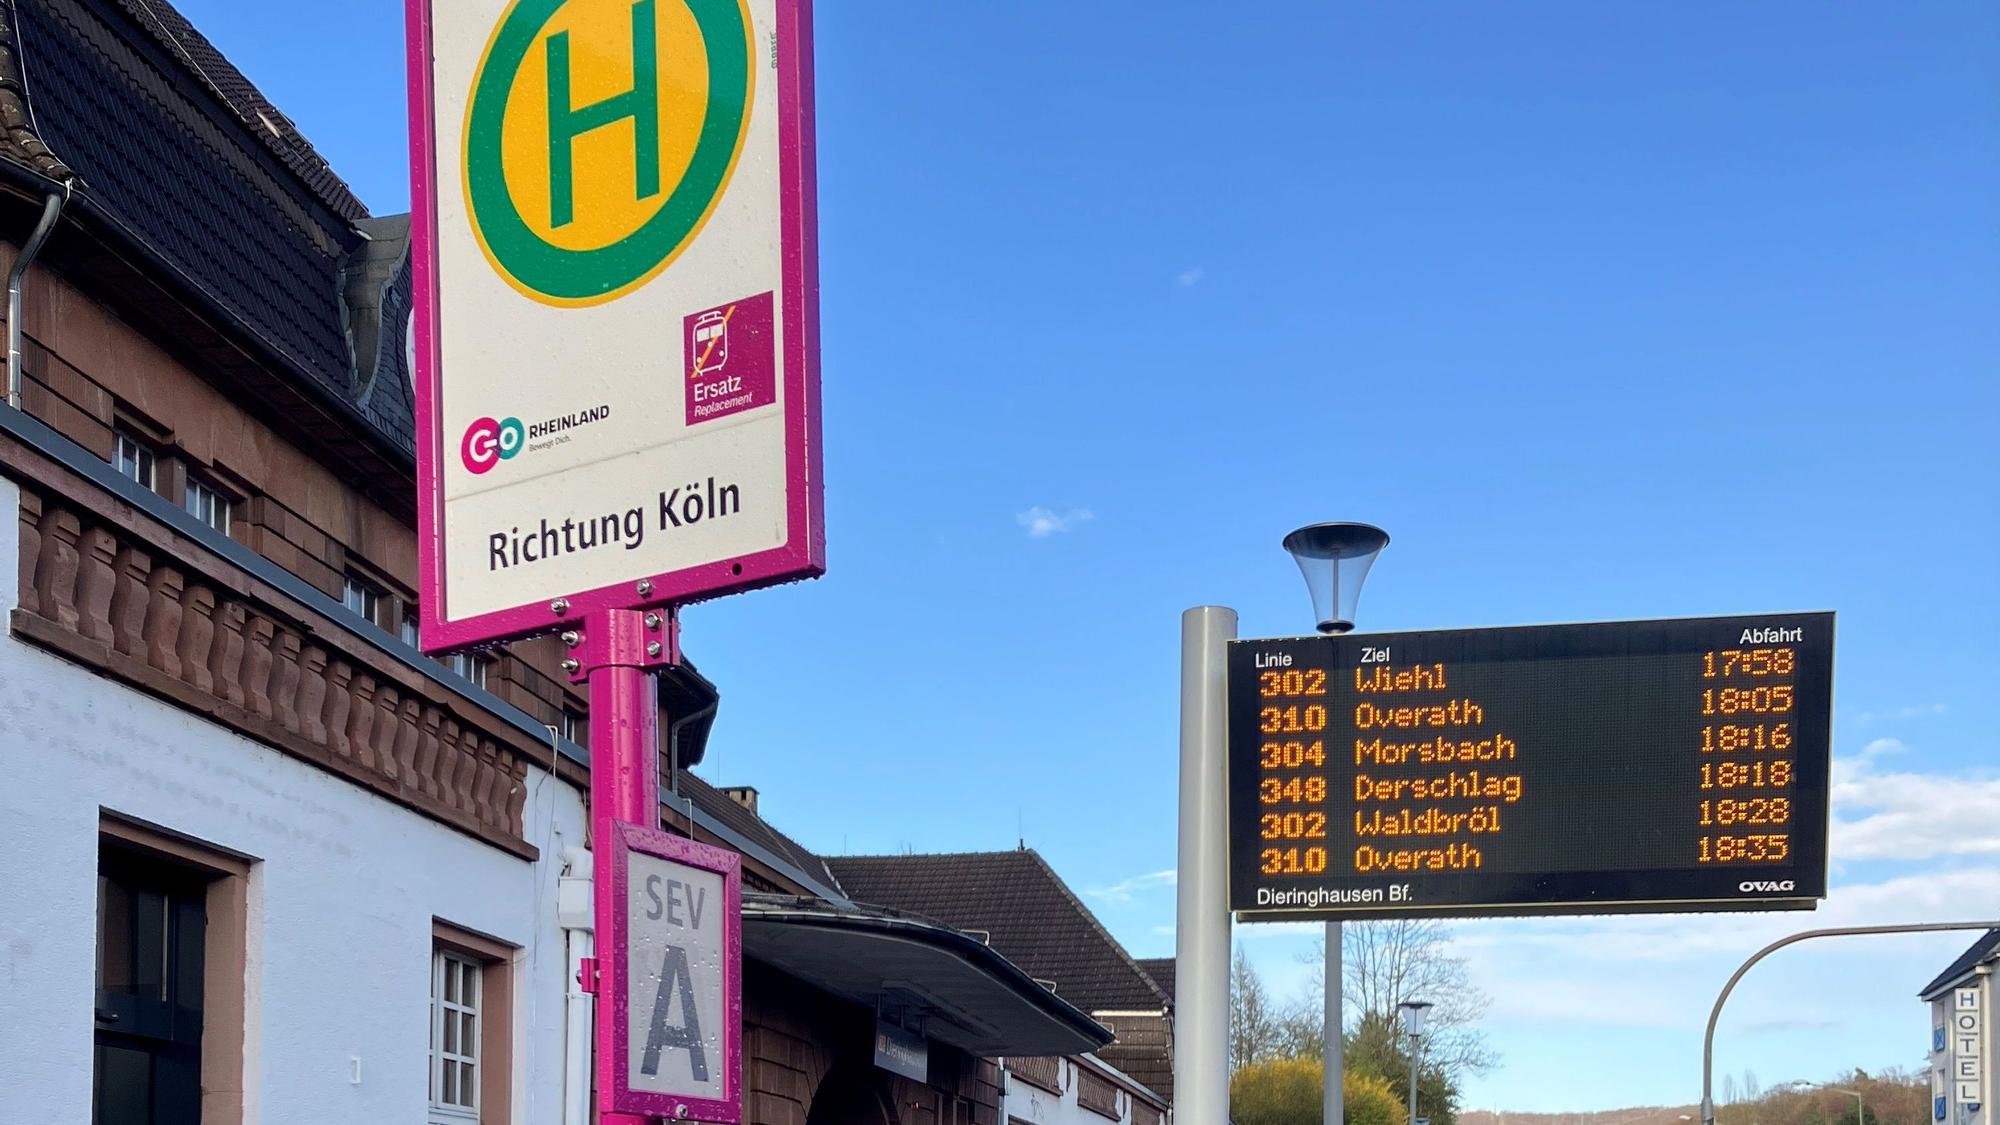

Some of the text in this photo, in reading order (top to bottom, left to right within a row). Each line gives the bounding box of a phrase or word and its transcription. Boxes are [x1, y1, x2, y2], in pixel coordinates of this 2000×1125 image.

[546, 0, 660, 229] H
[694, 376, 742, 402] Ersatz
[694, 392, 753, 417] Replacement
[529, 405, 610, 439] RHEINLAND
[529, 438, 554, 453] Bewegt
[489, 476, 740, 571] Richtung Köln
[1255, 627, 1802, 668] Linie Ziel Abfahrt
[1260, 648, 1794, 697] 302 Wiehl 17:58
[1260, 686, 1793, 733] 310 Overath 18:05
[1260, 723, 1792, 768] 304 Morsbach 18:16
[1260, 761, 1792, 803] 348 Derschlag 18:18
[1260, 798, 1790, 839] 302 Waldbröl 18:28
[1260, 834, 1789, 874] 310 Overath 18:35
[645, 873, 706, 930] SEV
[1257, 885, 1413, 906] Dieringhausen Bf.
[1739, 880, 1796, 893] OVAG
[640, 944, 710, 1082] A
[1959, 992, 1976, 1100] HOTEL
